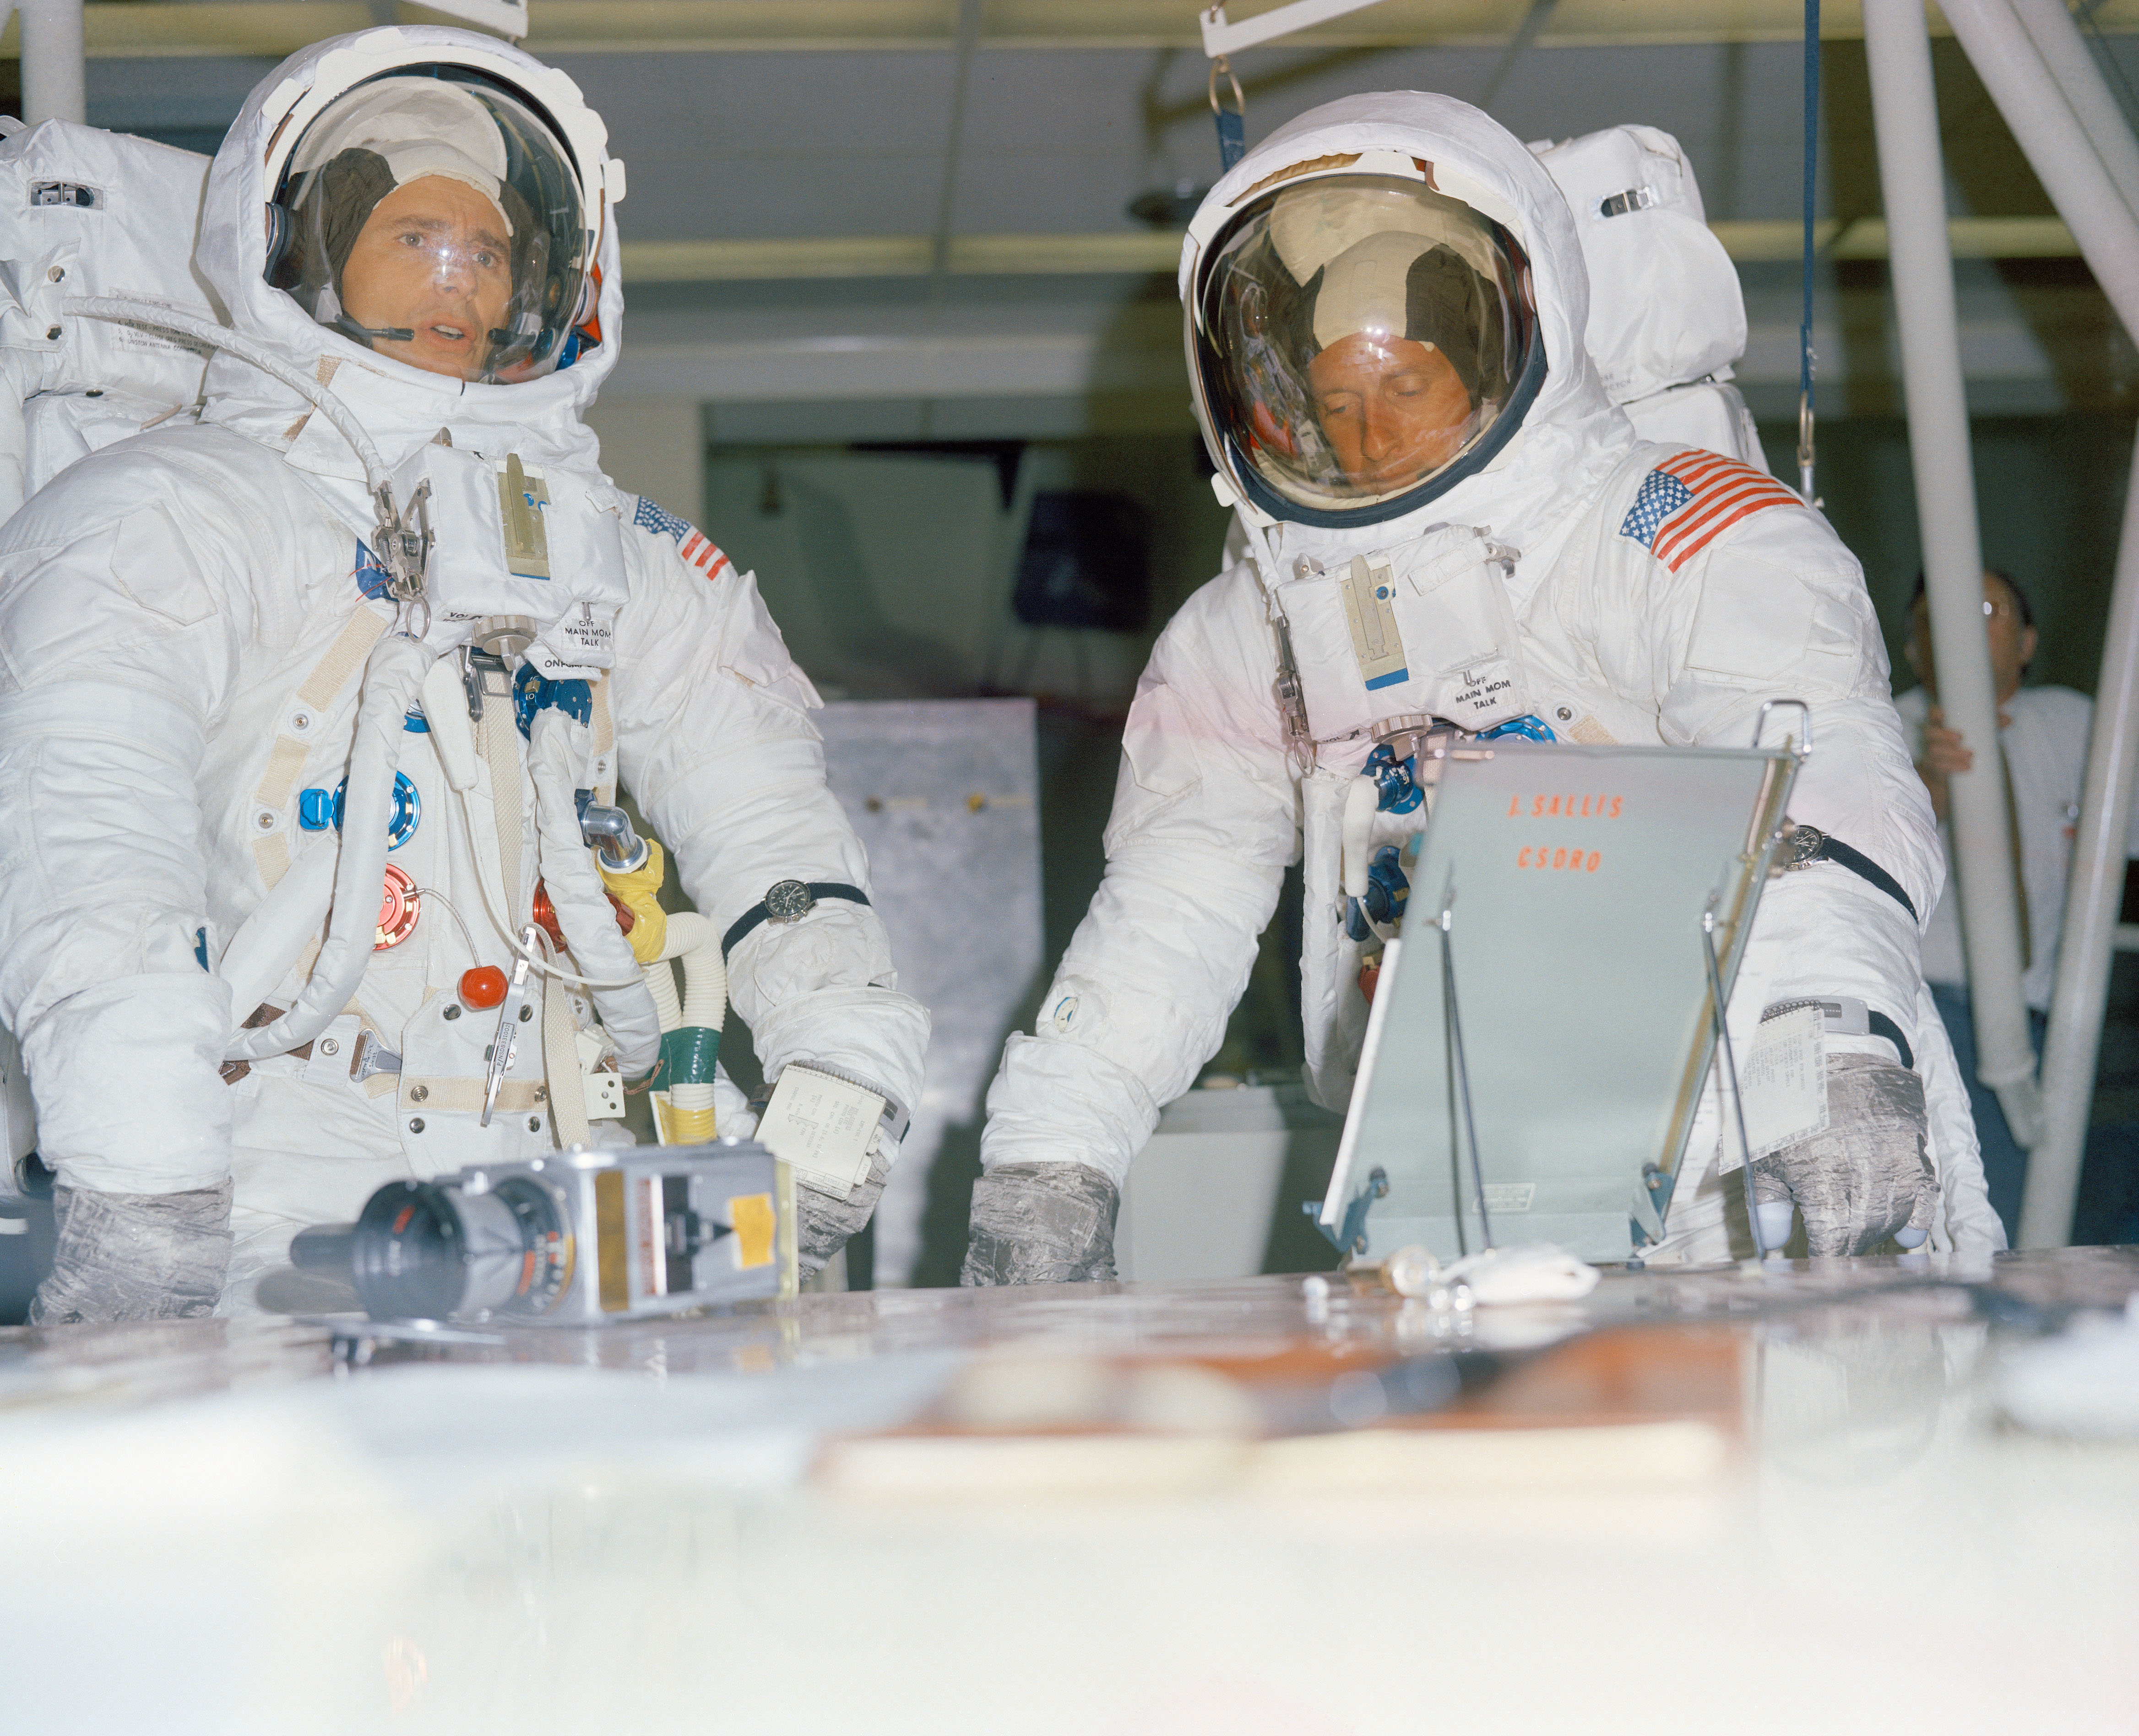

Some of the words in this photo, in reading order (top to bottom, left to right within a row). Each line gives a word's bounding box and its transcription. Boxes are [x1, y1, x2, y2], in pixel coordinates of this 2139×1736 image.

[564, 627, 588, 635] MAIN
[591, 629, 611, 638] MOM
[580, 637, 599, 646] TALK
[1455, 689, 1482, 703] MAIN
[1484, 679, 1511, 693] MOM
[1473, 696, 1497, 710] TALK
[1531, 795, 1623, 818] SALLIS
